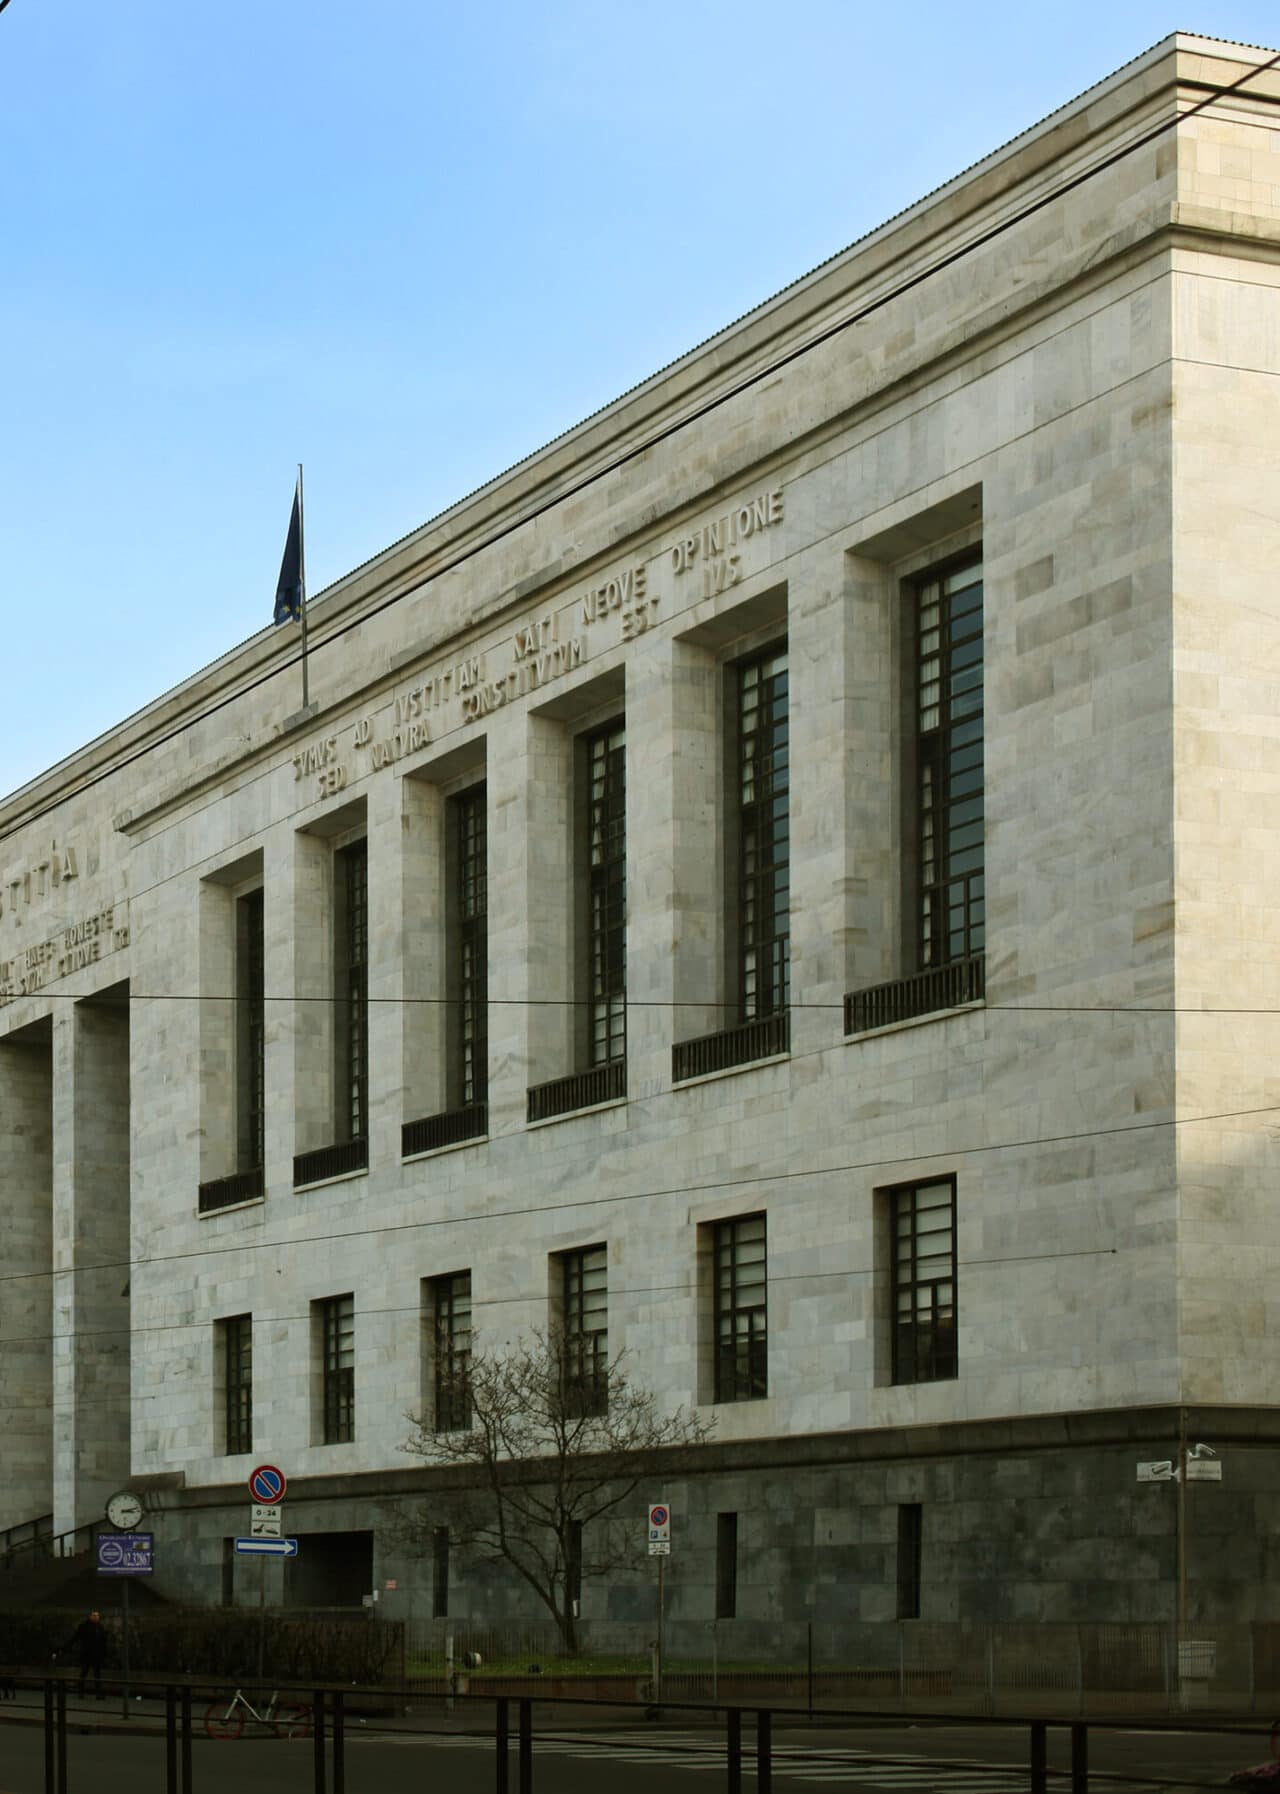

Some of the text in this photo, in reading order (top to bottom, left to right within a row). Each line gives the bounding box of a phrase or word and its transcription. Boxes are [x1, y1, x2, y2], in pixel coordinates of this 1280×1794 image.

[293, 488, 786, 782] SVMVS AD IVSTITIAM NATI NEQVE OPINIONE
[316, 554, 743, 800] SED NATVRA CONSTITVTVM EST IVS
